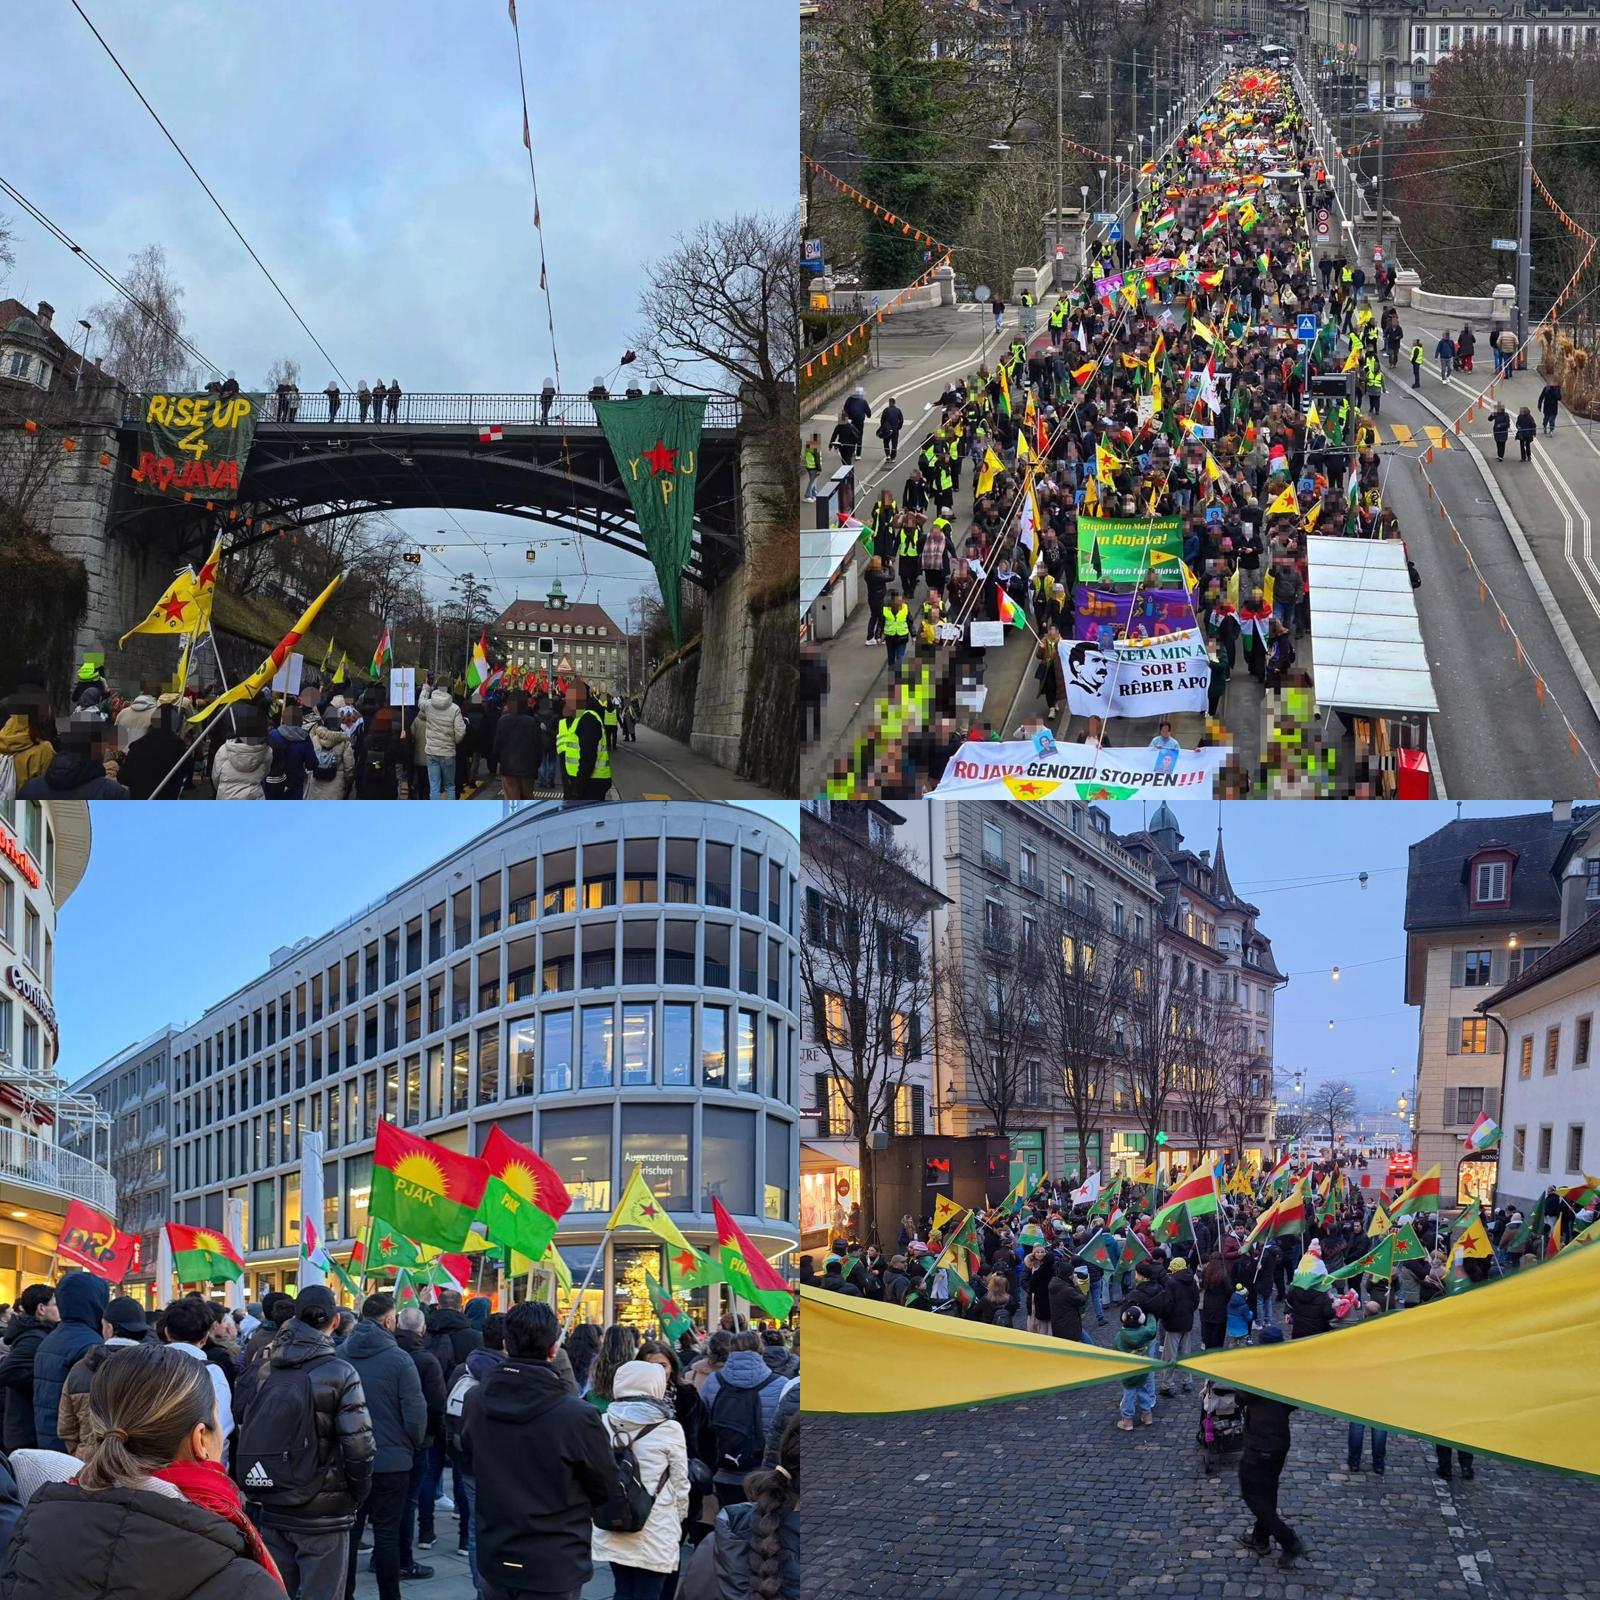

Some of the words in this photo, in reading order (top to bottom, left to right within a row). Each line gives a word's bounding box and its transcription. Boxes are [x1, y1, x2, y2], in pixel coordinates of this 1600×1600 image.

[212, 399, 251, 428] UP
[178, 427, 208, 460] 4
[140, 451, 239, 489] ROJAVA
[628, 458, 639, 480] Y
[681, 451, 694, 473] J
[661, 480, 673, 504] P
[1112, 534, 1168, 547] Rojava!
[1161, 646, 1191, 660] MIN
[1141, 663, 1173, 677] SOR
[1177, 662, 1187, 673] E
[1119, 679, 1174, 697] RÊBER
[1178, 677, 1207, 690] APO
[953, 760, 1025, 780] ROJAVA
[1027, 763, 1097, 781] GENOZID
[394, 1178, 436, 1207] PJAK
[245, 1477, 273, 1487] adidas
